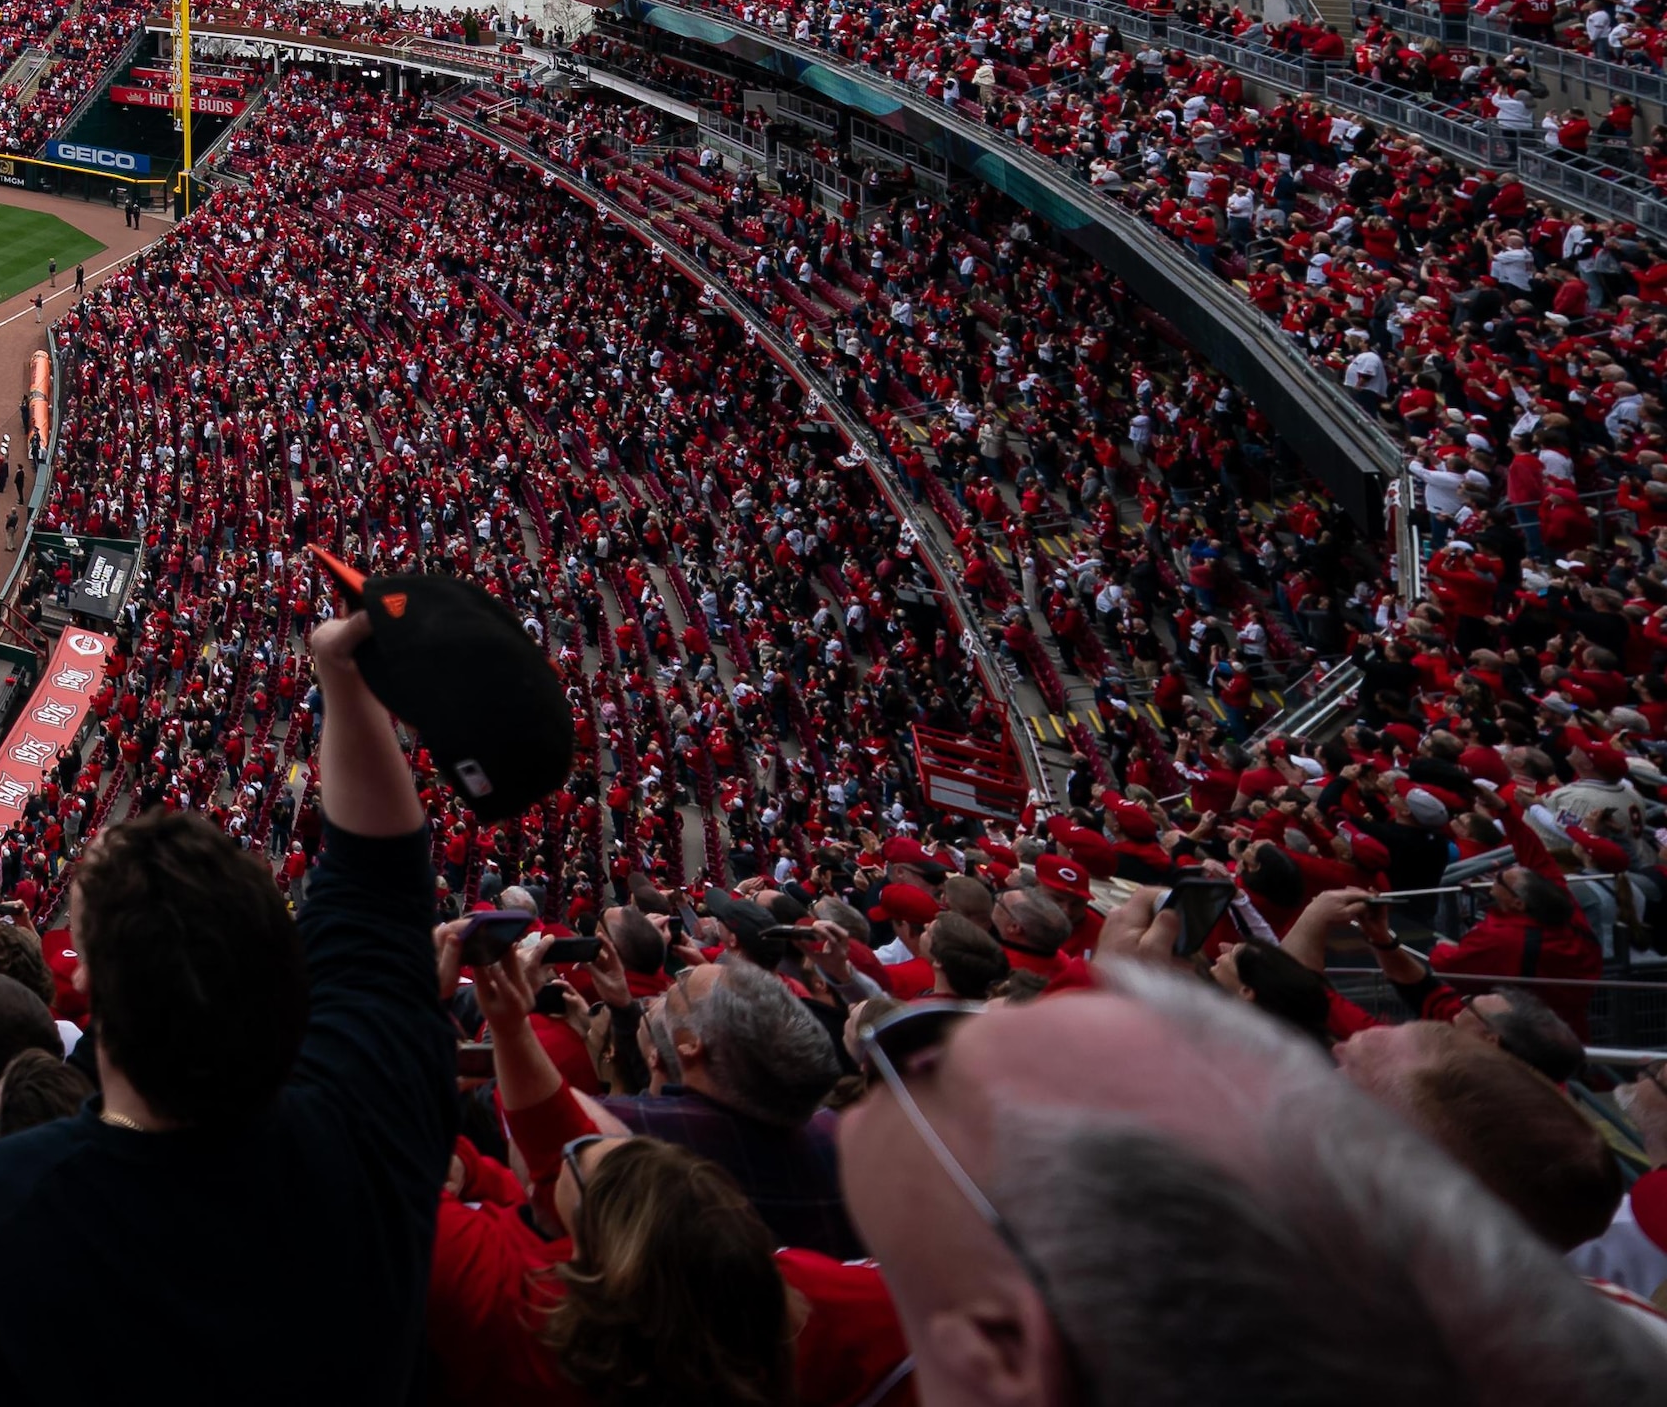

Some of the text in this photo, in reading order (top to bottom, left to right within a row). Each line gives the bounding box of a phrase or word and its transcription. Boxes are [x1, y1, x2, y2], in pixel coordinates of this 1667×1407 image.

[149, 93, 169, 106] HIT
[198, 96, 234, 114] BUDS
[58, 143, 136, 170] GEICO
[57, 669, 88, 689] 1990
[37, 703, 72, 725] 1976
[15, 741, 53, 765] 1975
